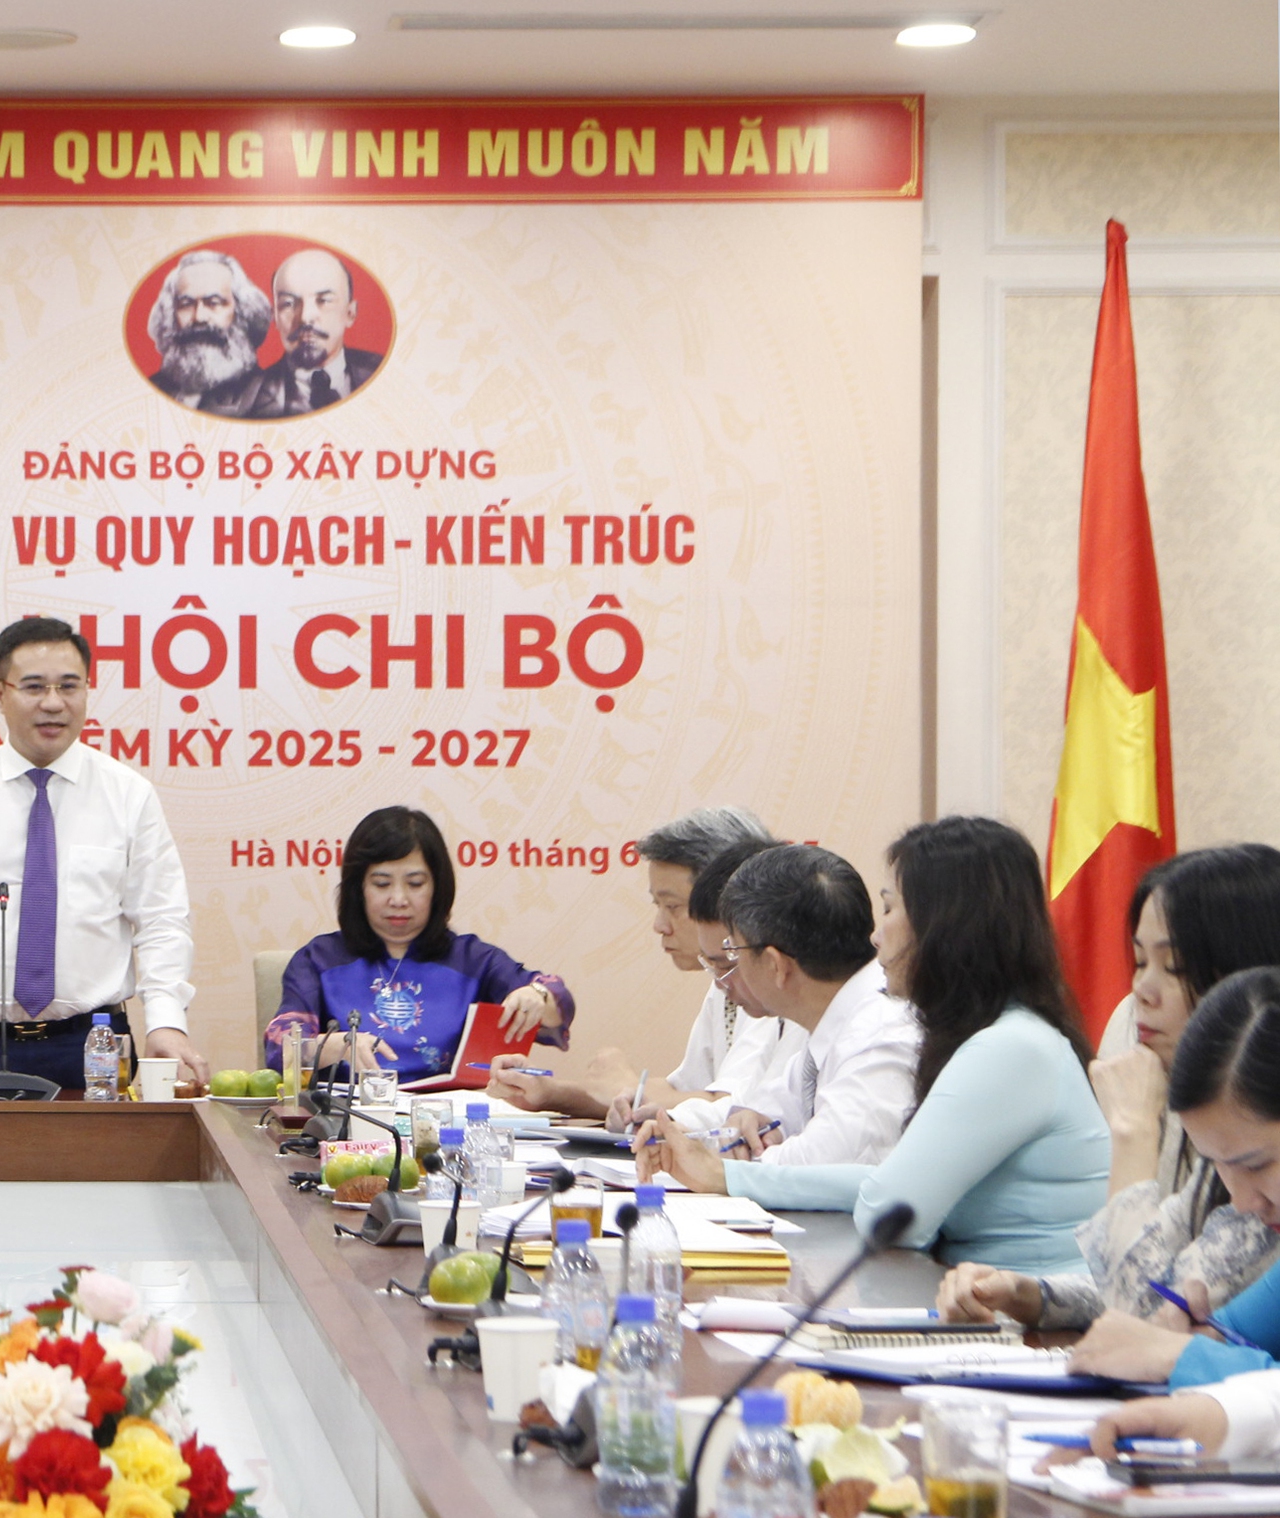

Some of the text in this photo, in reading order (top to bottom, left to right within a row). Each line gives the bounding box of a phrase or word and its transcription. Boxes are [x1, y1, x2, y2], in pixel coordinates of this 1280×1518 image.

[53, 130, 265, 184] QUANG
[290, 129, 440, 179] VINH
[467, 119, 656, 177] MUÔN
[682, 117, 831, 177] NĂM
[23, 443, 497, 489] ĐẢNG BỘ BỘ XÂY DỰNG
[13, 516, 77, 577] VỤ
[95, 515, 194, 572] QUY
[213, 514, 385, 577] HOẠCH
[426, 498, 546, 565] KIẾN
[563, 503, 695, 566] TRÚC
[79, 594, 258, 714] HỘI
[293, 613, 465, 691] CHI
[503, 593, 644, 713] BỘ
[169, 716, 232, 768] KỲ
[248, 729, 362, 768] 2025
[411, 729, 531, 768] 2027
[231, 838, 641, 875] Hà Nội 09 tháng 6
